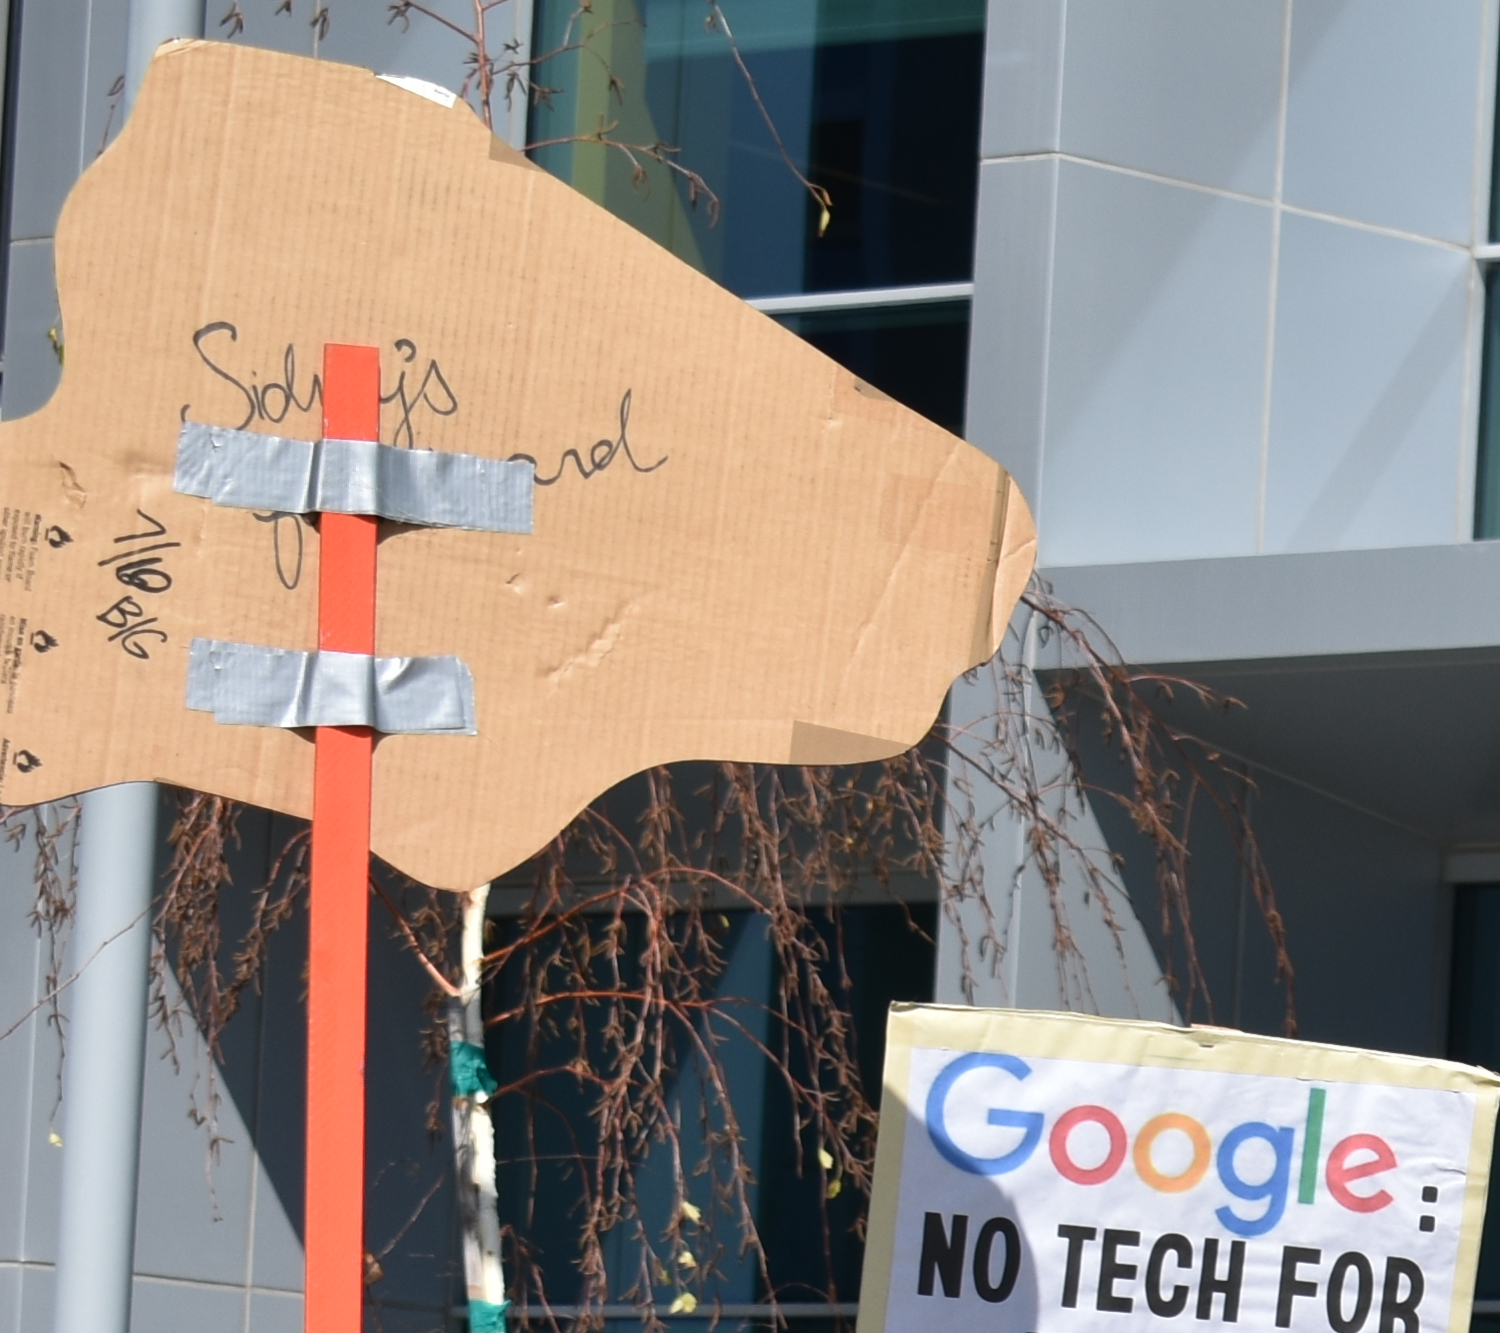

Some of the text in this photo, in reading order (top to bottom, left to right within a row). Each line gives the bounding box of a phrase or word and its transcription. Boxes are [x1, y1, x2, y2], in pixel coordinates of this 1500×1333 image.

[925, 1051, 1439, 1239] Google:
[918, 1211, 1021, 1303] NO
[1057, 1223, 1243, 1323] TECH
